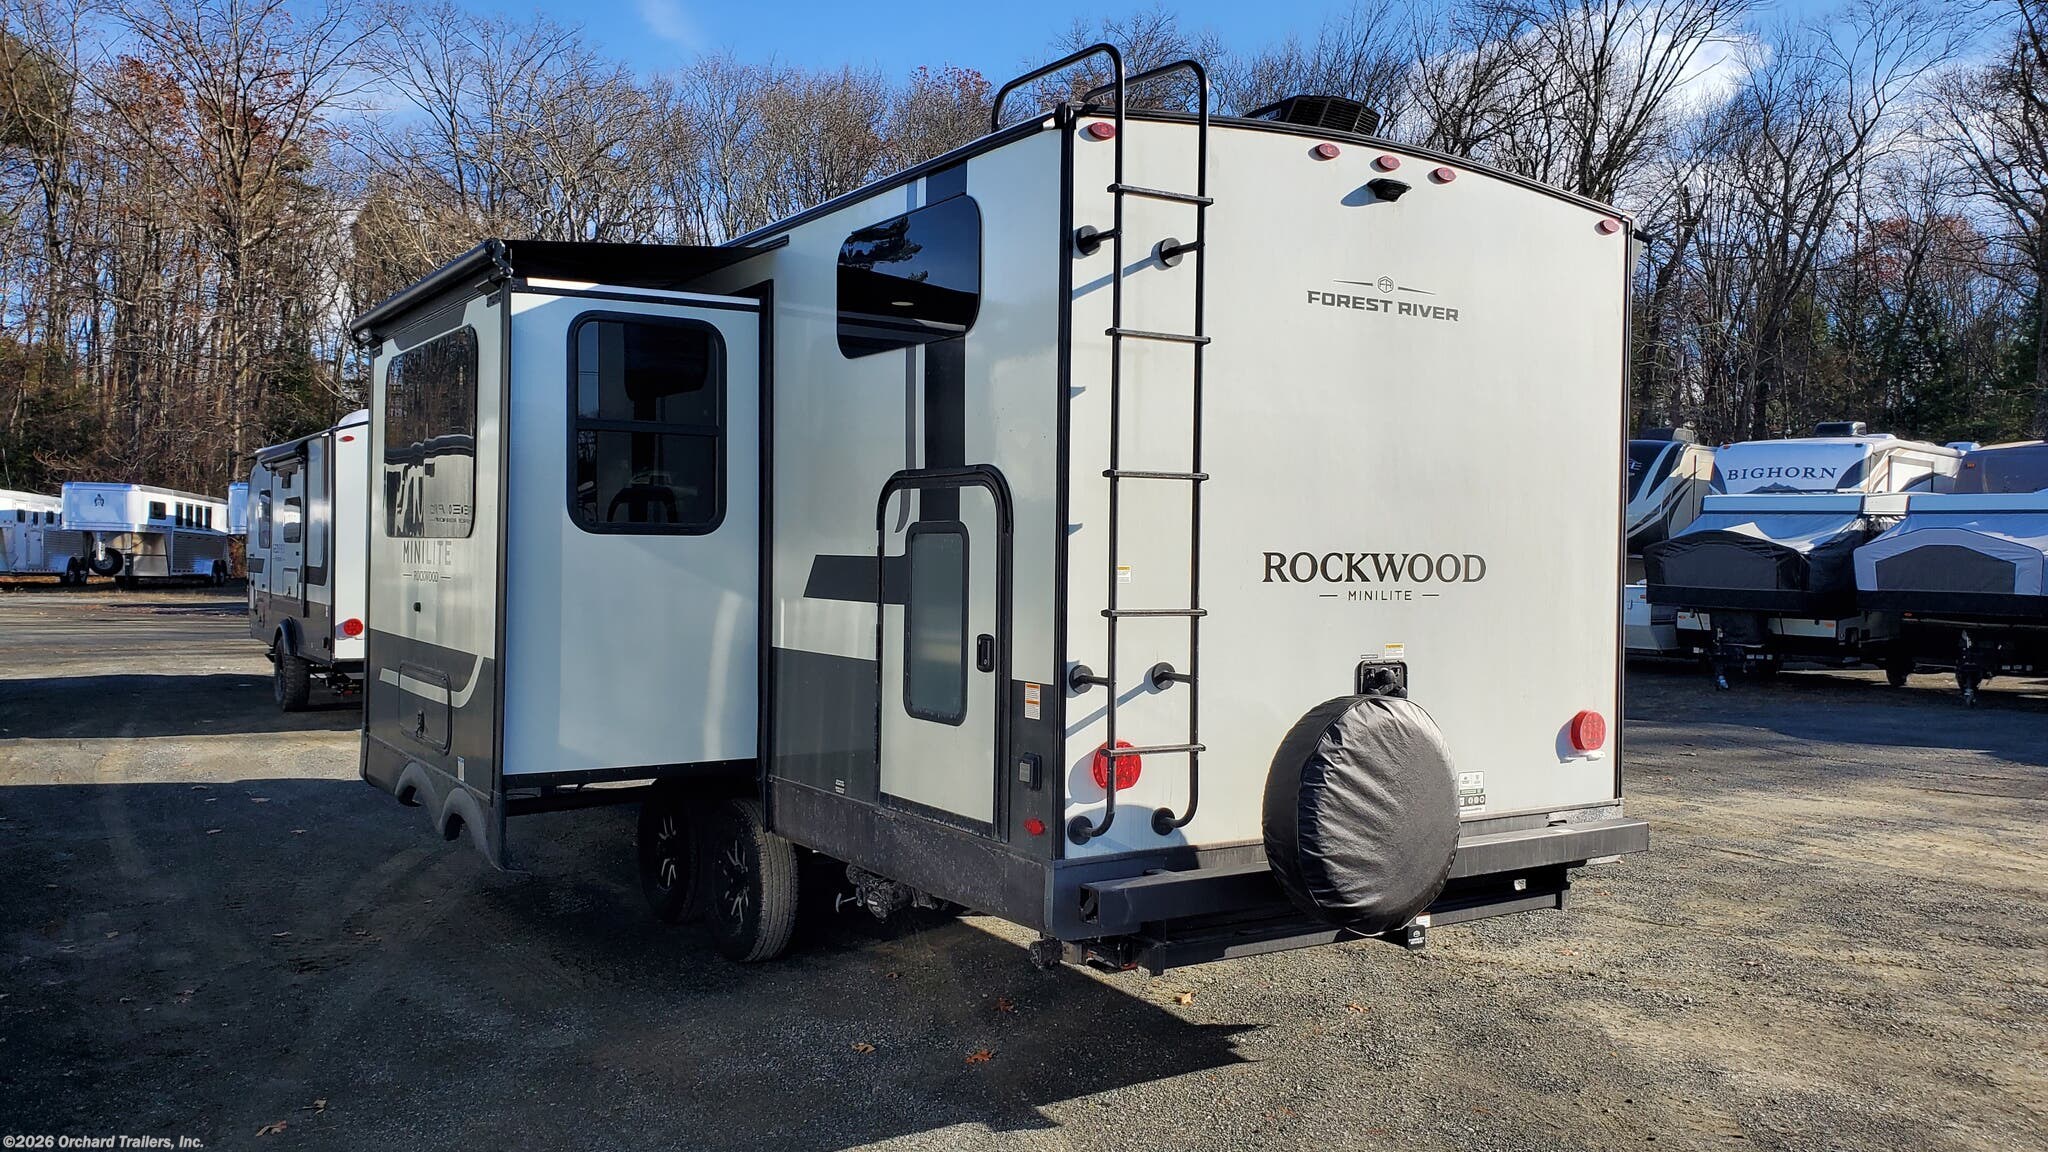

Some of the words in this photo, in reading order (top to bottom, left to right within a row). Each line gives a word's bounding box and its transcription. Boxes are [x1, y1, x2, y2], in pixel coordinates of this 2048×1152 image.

[1307, 290, 1392, 313] FOREST
[1397, 301, 1459, 322] RIVER
[1727, 467, 1837, 481] BIGHORN
[403, 540, 452, 565] MINILITE
[1262, 552, 1487, 583] ROCKWOOD
[1347, 590, 1413, 602] MINILITE
